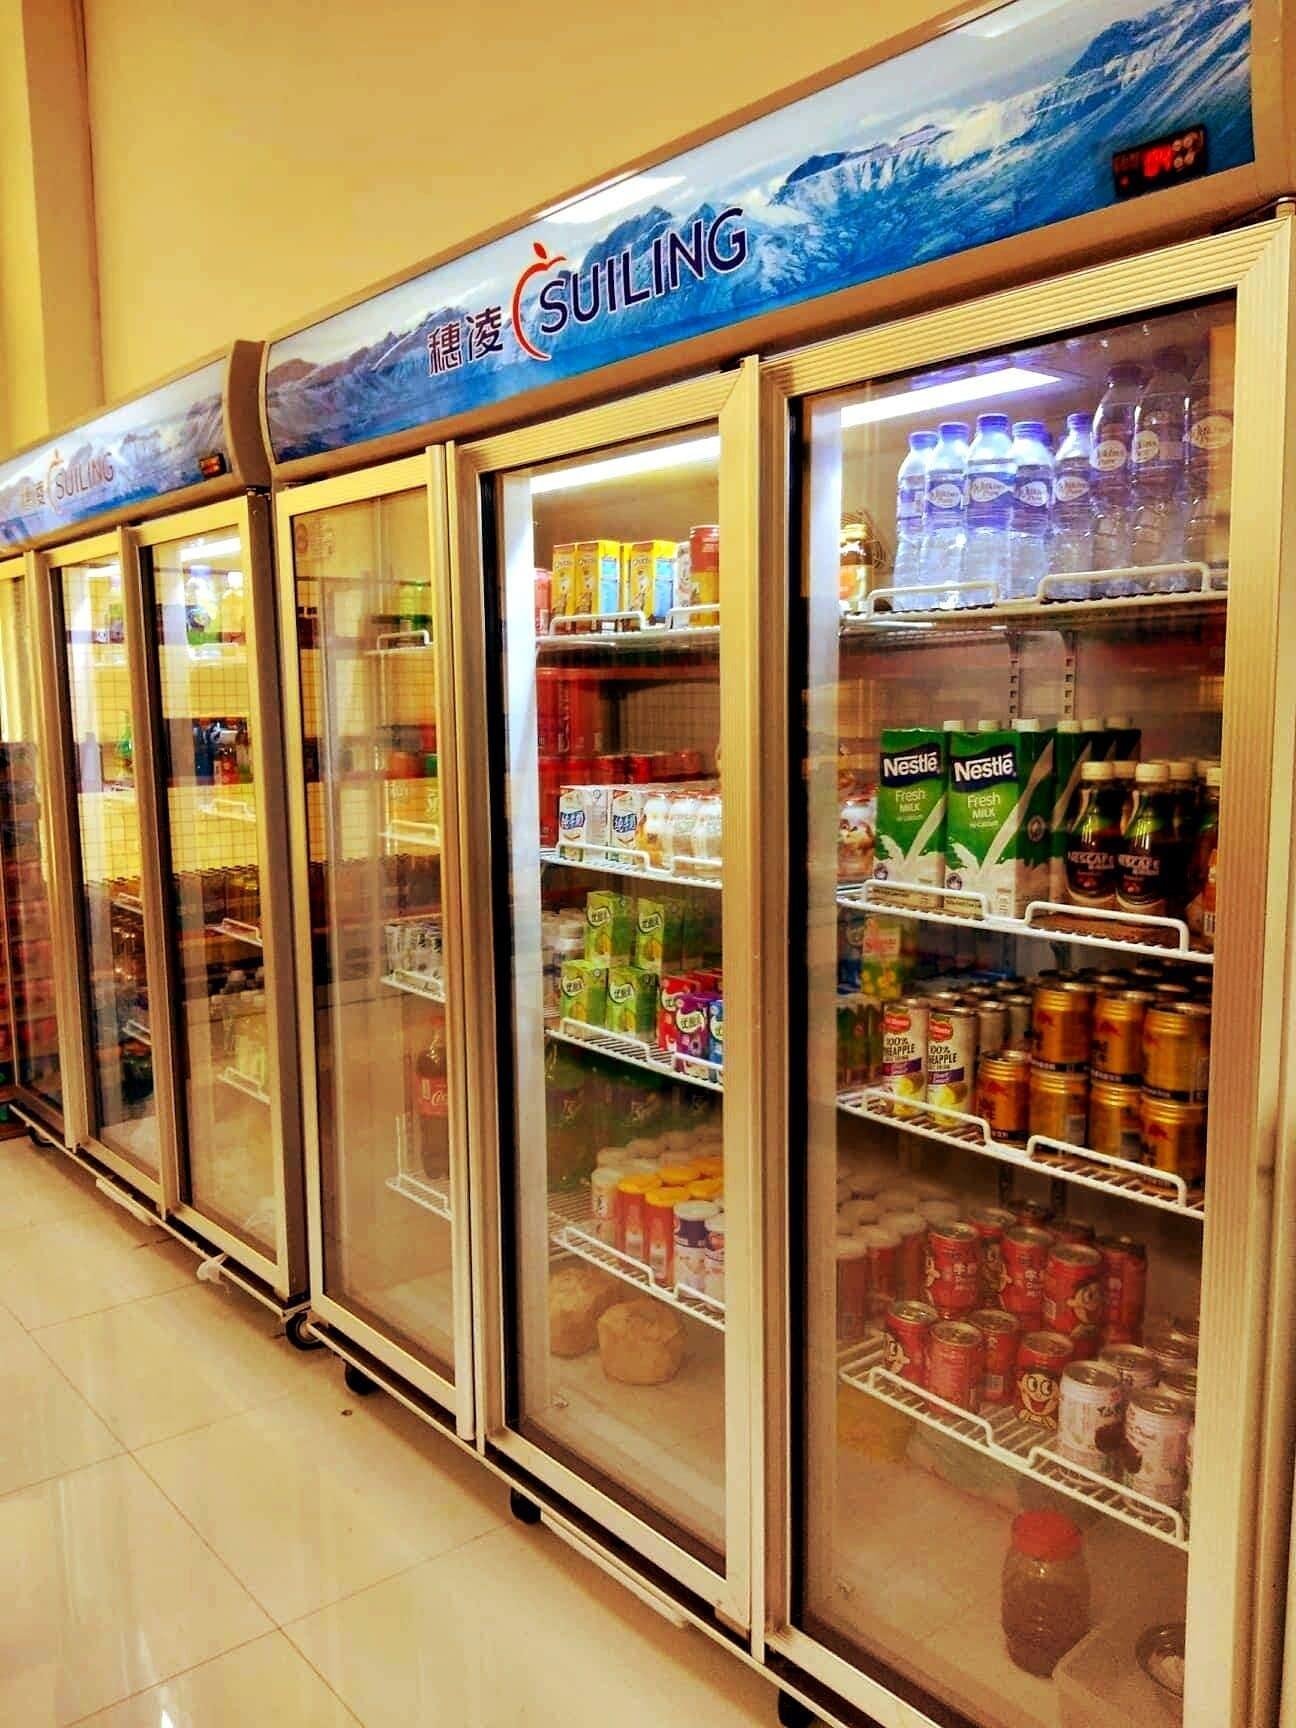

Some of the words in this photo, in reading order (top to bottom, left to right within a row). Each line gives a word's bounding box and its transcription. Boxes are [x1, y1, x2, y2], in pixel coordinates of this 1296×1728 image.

[540, 206, 747, 334] SUILING
[55, 452, 114, 499] SUILING
[884, 751, 940, 777] Nestlé
[954, 752, 1014, 782] Nestlé
[895, 788, 925, 802] Fresh
[967, 792, 1001, 808] Fresh
